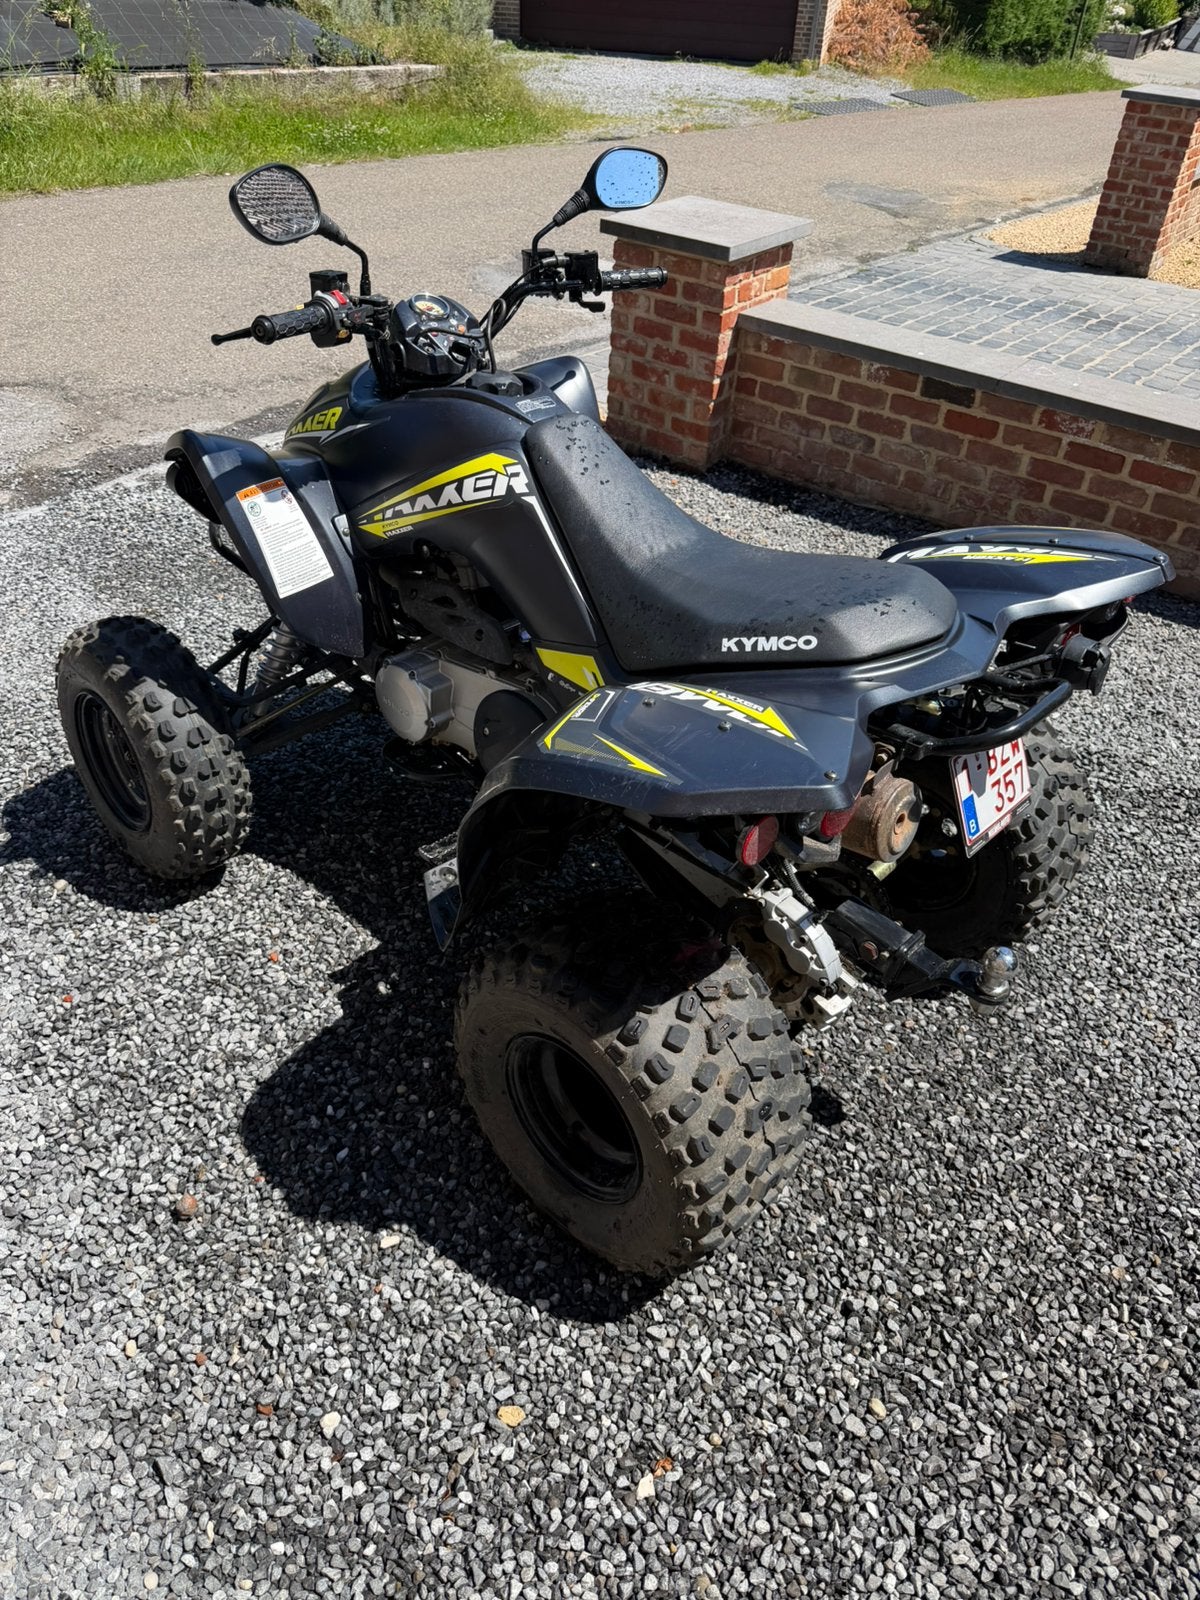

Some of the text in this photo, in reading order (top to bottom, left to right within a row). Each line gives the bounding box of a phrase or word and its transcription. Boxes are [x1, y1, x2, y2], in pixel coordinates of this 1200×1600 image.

[721, 635, 818, 652] KYMCO
[991, 760, 1024, 813] 357
[969, 819, 977, 834] B
